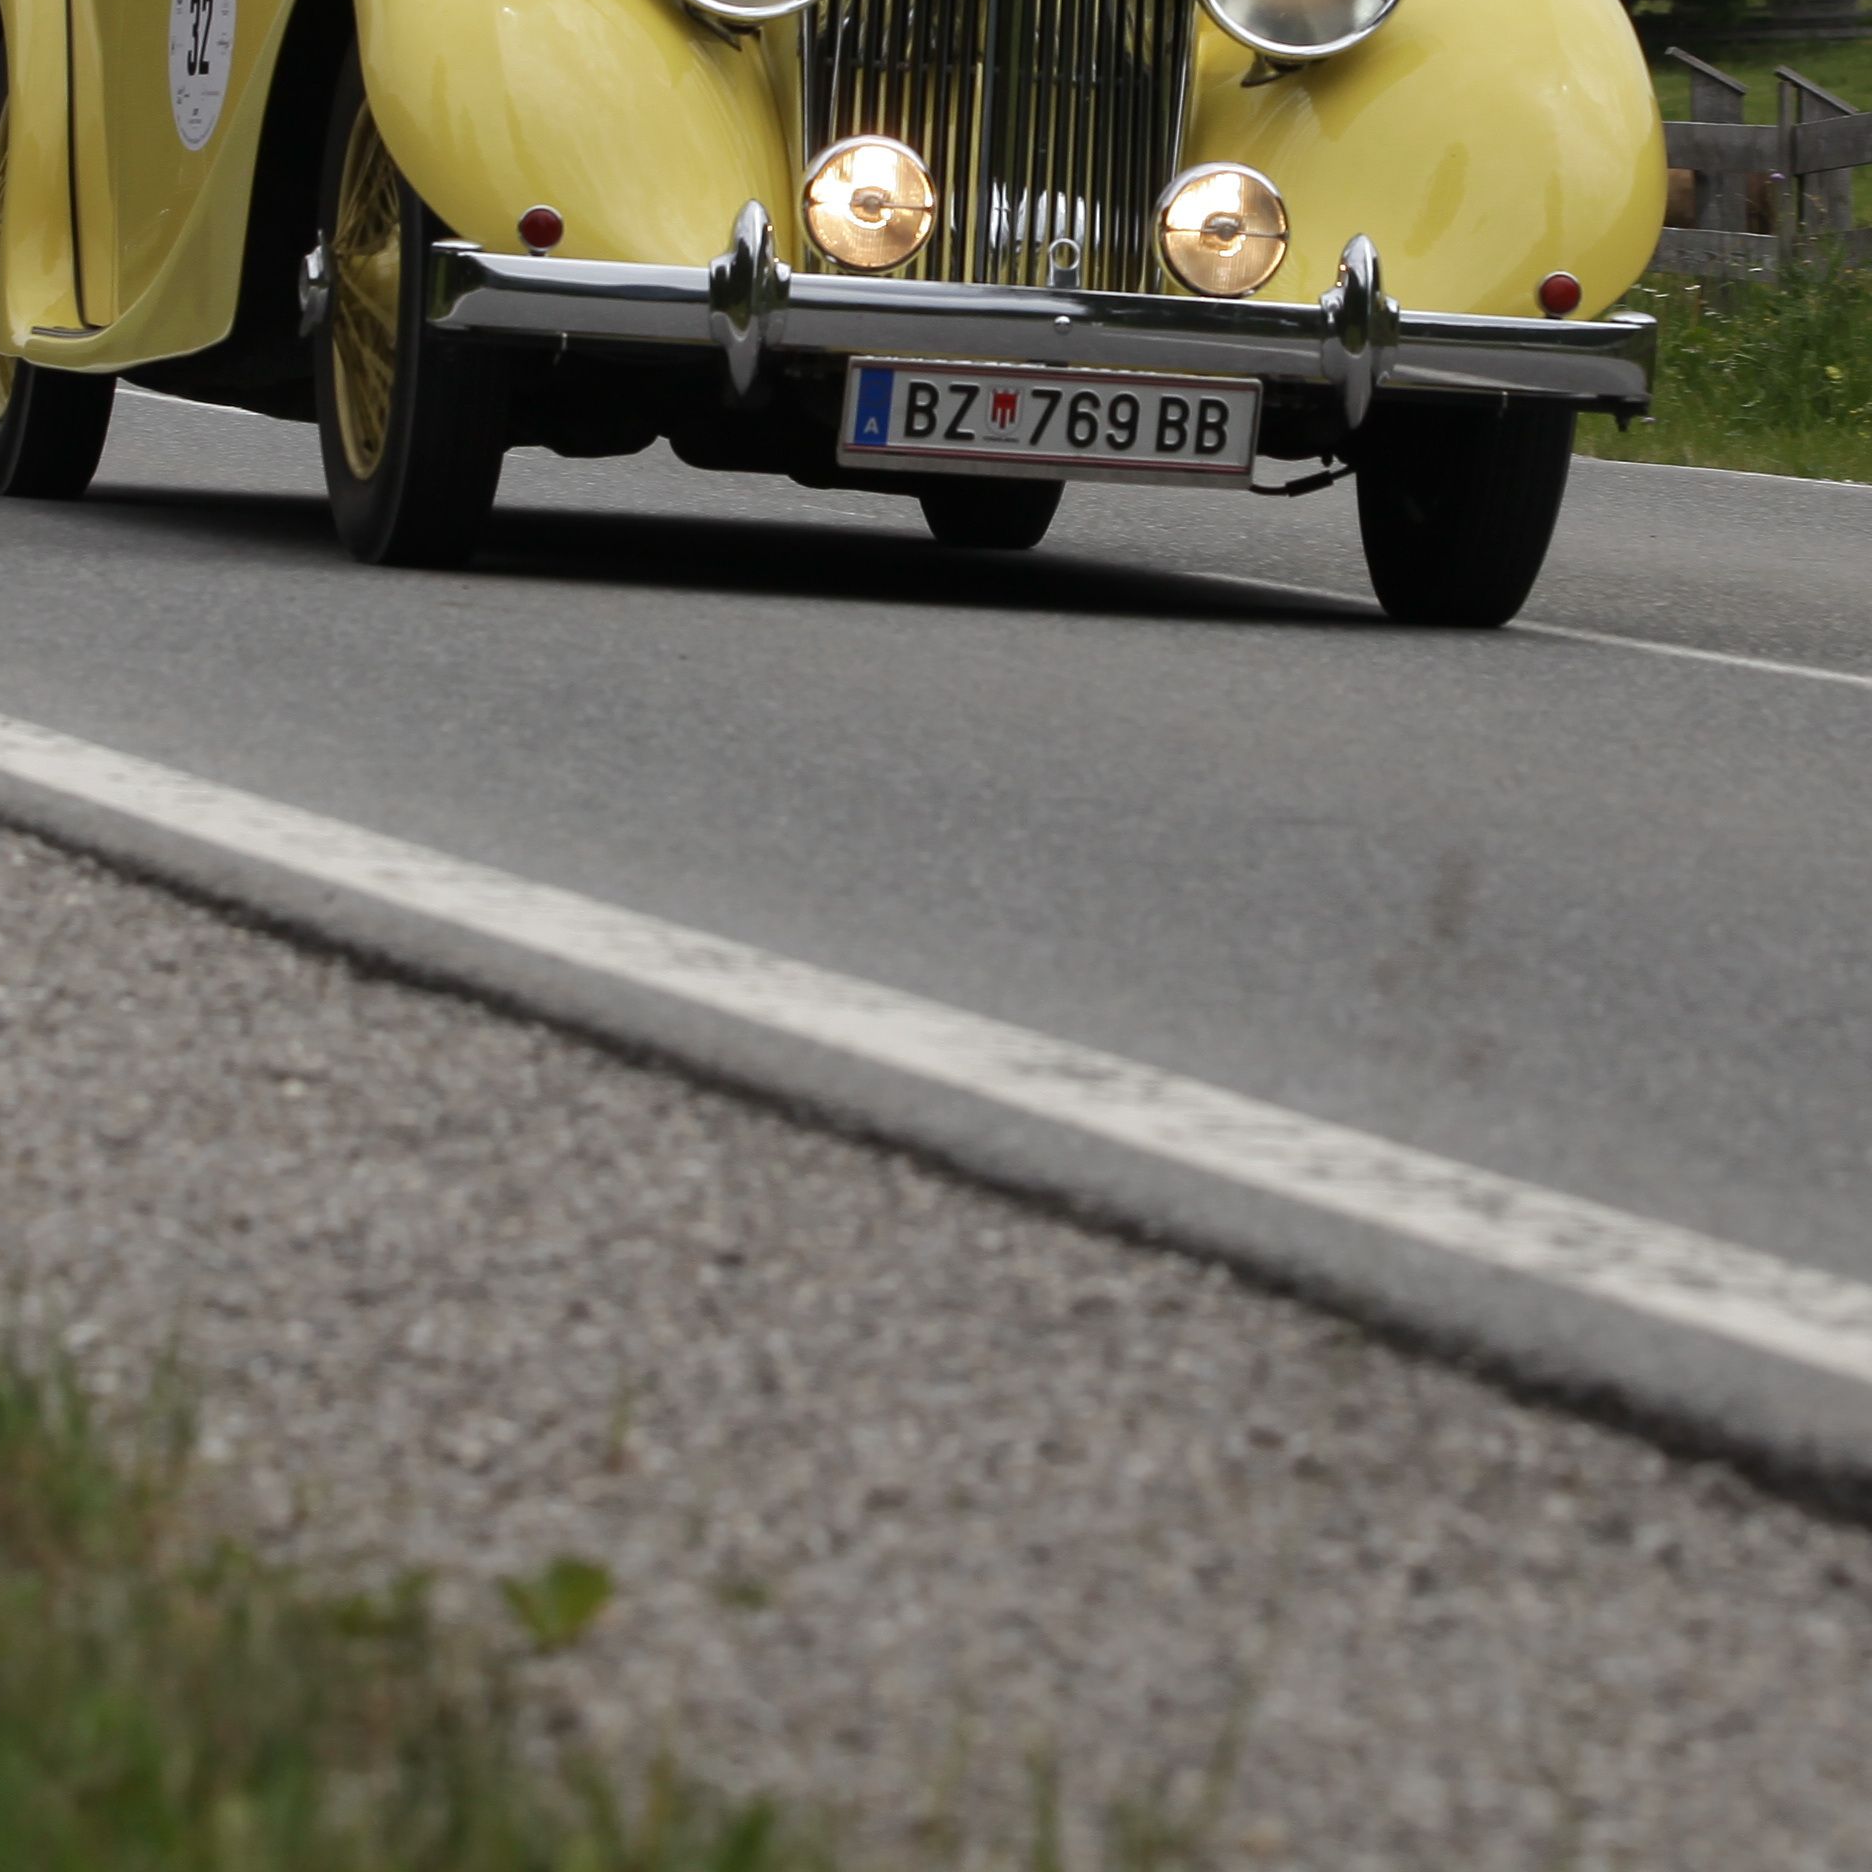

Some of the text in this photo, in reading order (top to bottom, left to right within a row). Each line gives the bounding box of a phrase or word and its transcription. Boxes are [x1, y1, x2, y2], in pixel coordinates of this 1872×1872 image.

[863, 416, 879, 435] A
[903, 380, 1230, 455] BZ 769 BB
